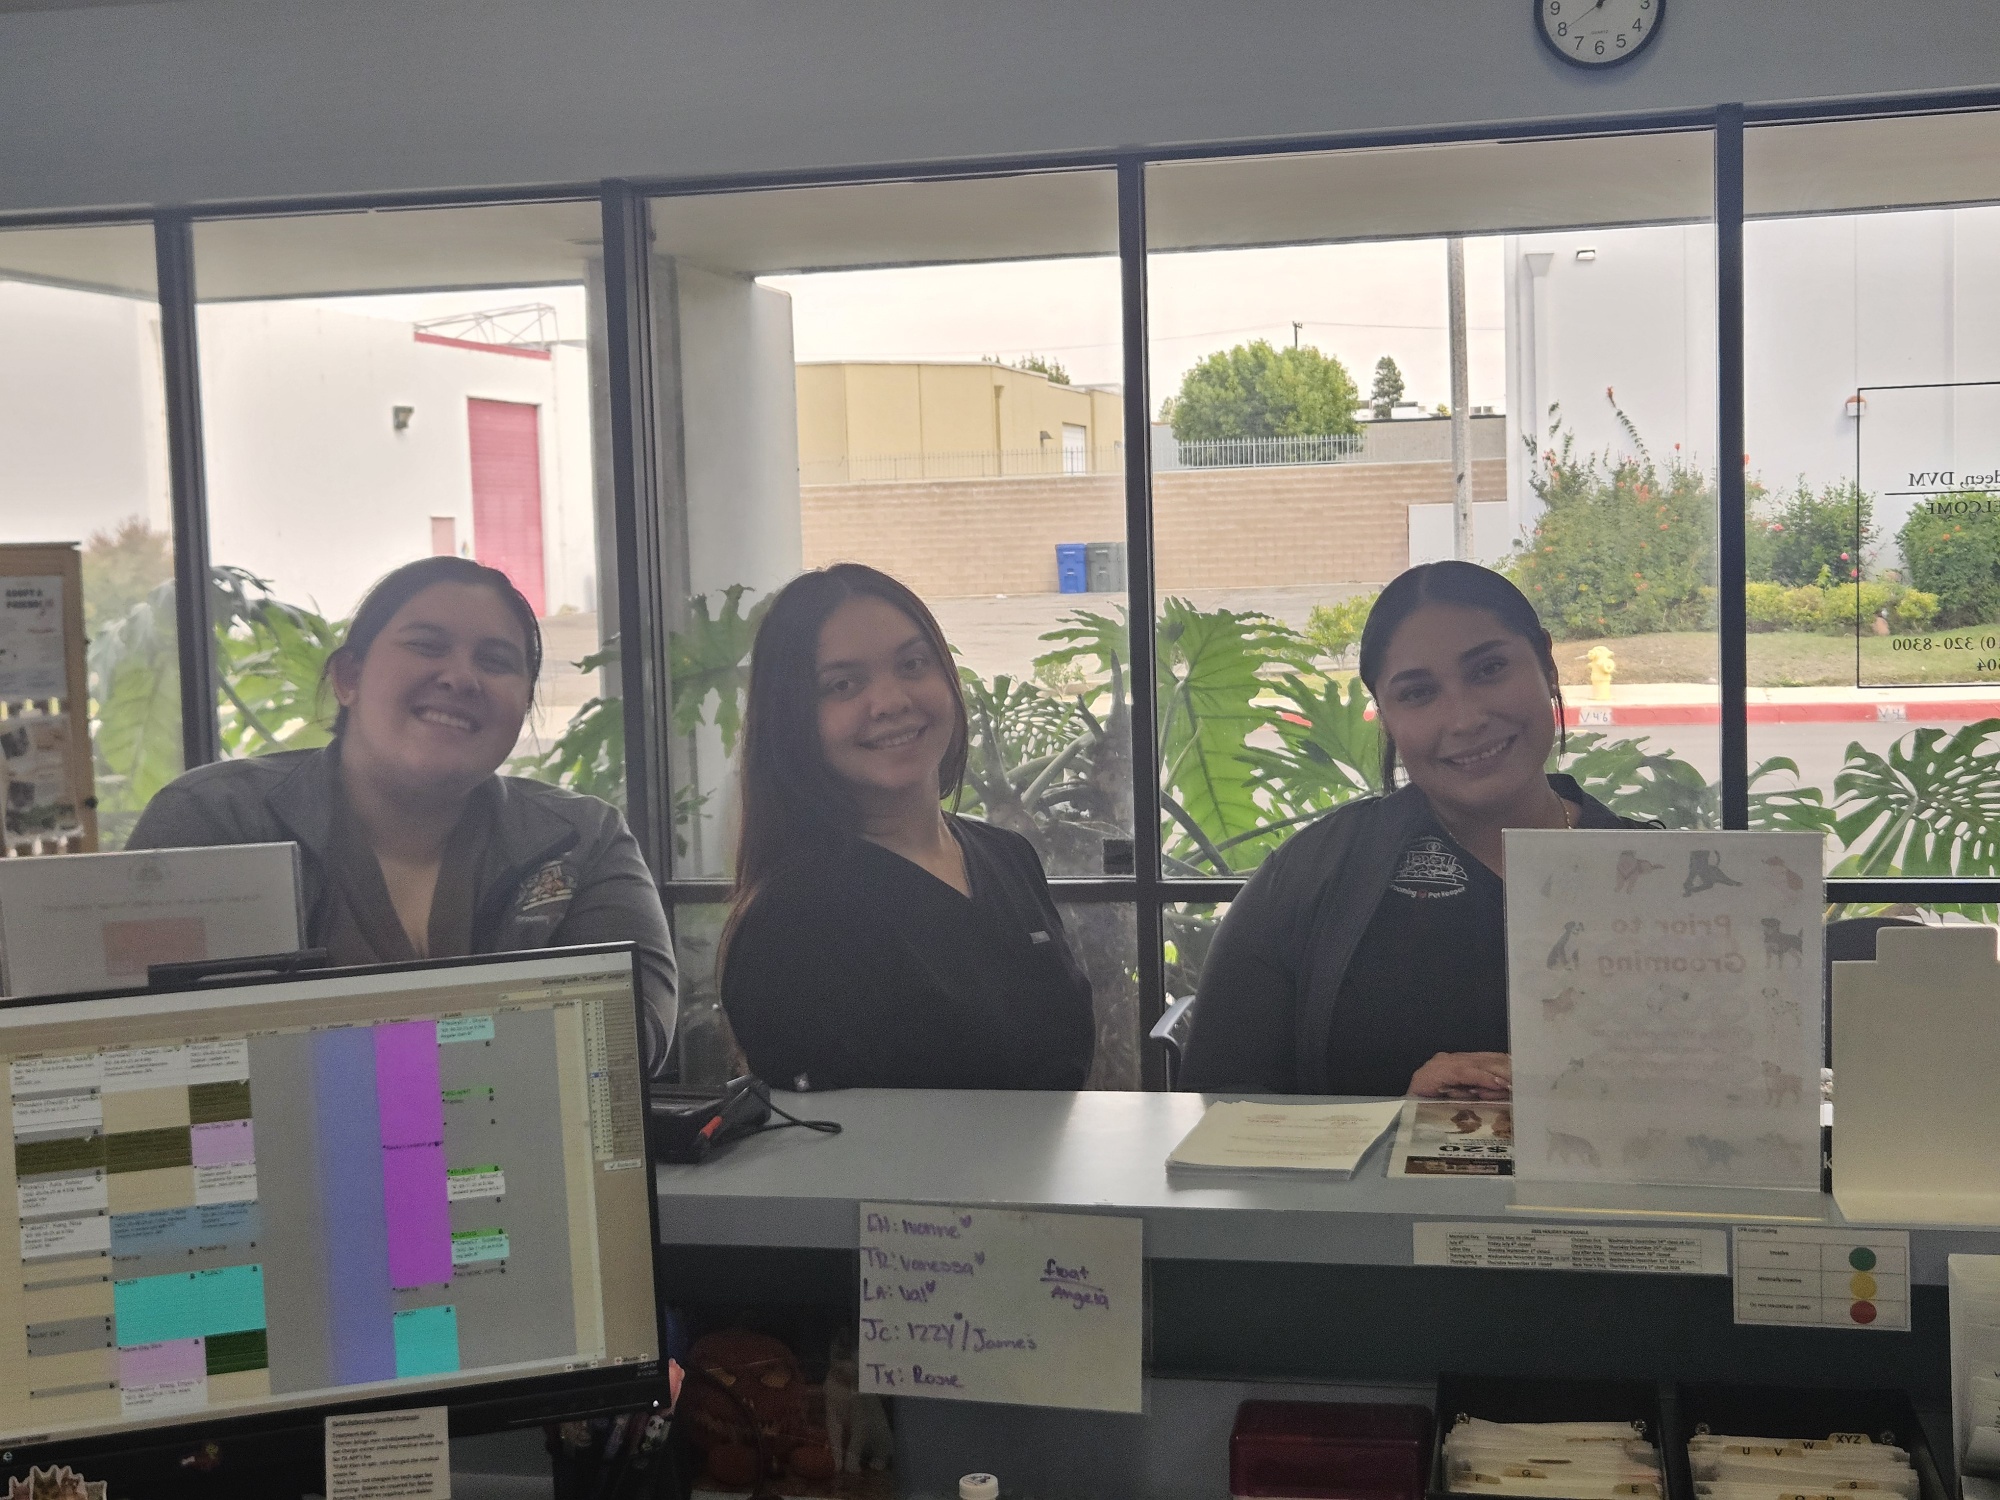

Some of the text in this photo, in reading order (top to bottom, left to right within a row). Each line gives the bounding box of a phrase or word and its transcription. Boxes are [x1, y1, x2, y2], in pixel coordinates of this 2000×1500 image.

[1550, 1, 1560, 15] 9
[1640, 0, 1650, 9] 3
[1558, 22, 1567, 36] 8
[1632, 18, 1642, 32] 4
[1574, 36, 1584, 50] 7
[1616, 34, 1626, 48] 5
[1595, 41, 1604, 54] 6
[1836, 1434, 1862, 1445] XYZ
[1742, 1447, 1750, 1455] U
[1774, 1448, 1783, 1456] V
[1475, 1474, 1482, 1482] F
[1521, 1469, 1531, 1477] G
[1631, 1485, 1639, 1494] E
[1849, 1481, 1858, 1490] S
